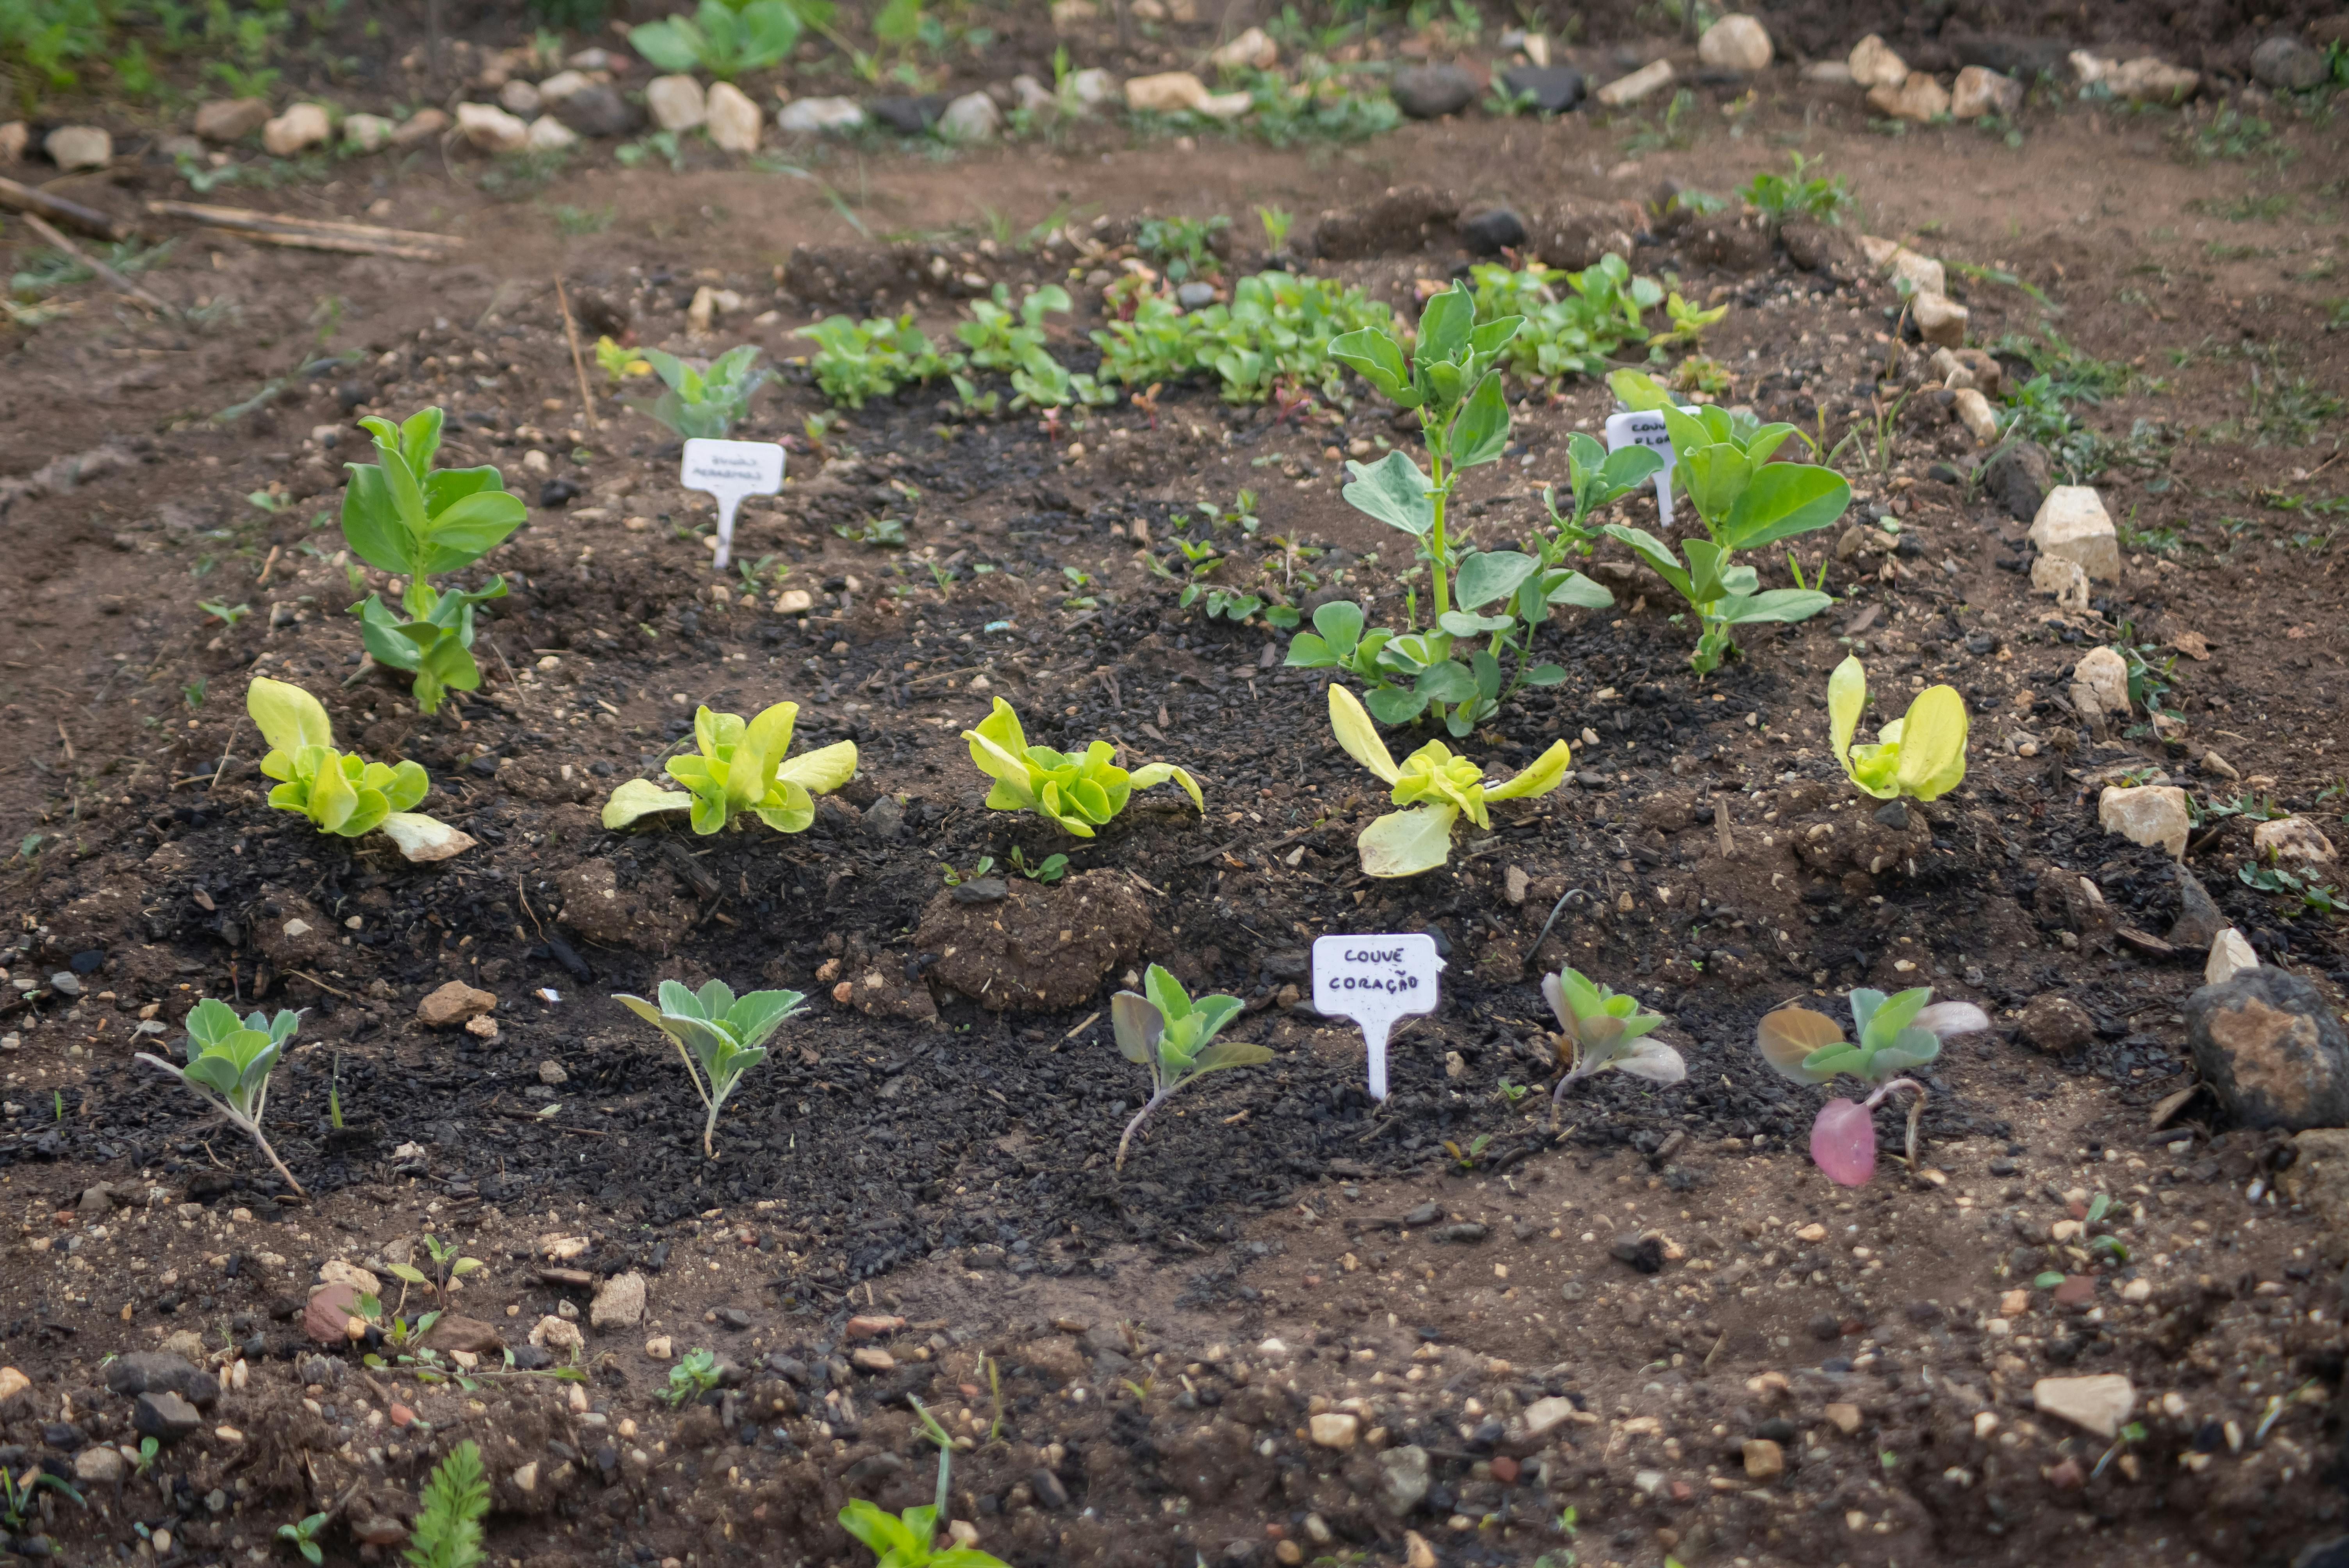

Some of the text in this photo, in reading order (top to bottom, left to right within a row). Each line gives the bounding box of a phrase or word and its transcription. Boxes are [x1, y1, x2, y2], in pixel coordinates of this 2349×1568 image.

[1631, 422, 1666, 431] COUV
[1344, 947, 1404, 962] COUVE
[1329, 969, 1419, 994] CORAÇÃO
